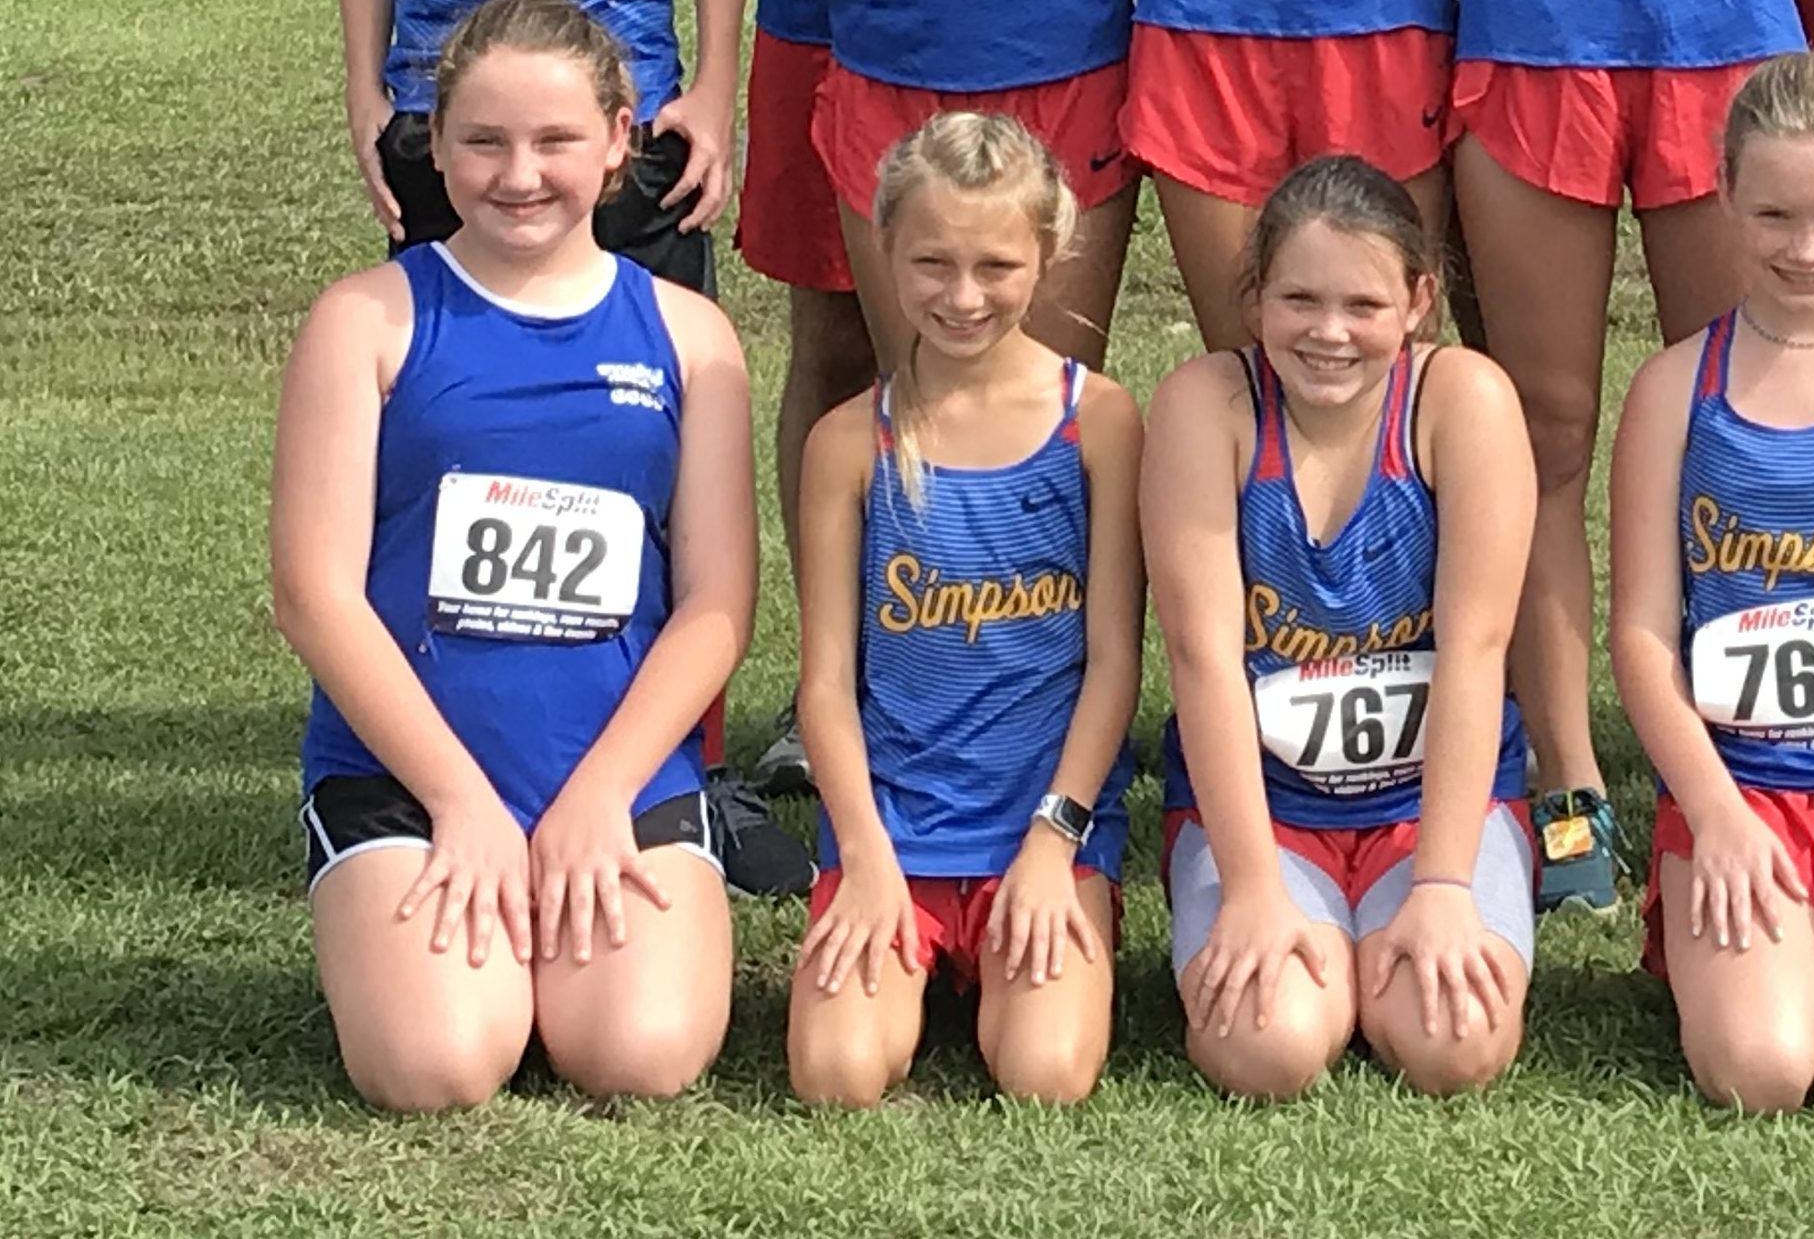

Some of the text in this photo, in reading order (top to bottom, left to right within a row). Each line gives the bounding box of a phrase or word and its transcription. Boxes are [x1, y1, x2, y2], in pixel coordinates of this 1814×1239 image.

[485, 479, 601, 516] MileSplit
[462, 517, 608, 606] 842
[878, 553, 1082, 645] Simpson
[1299, 653, 1411, 682] MileSplit
[1289, 682, 1430, 766] 767
